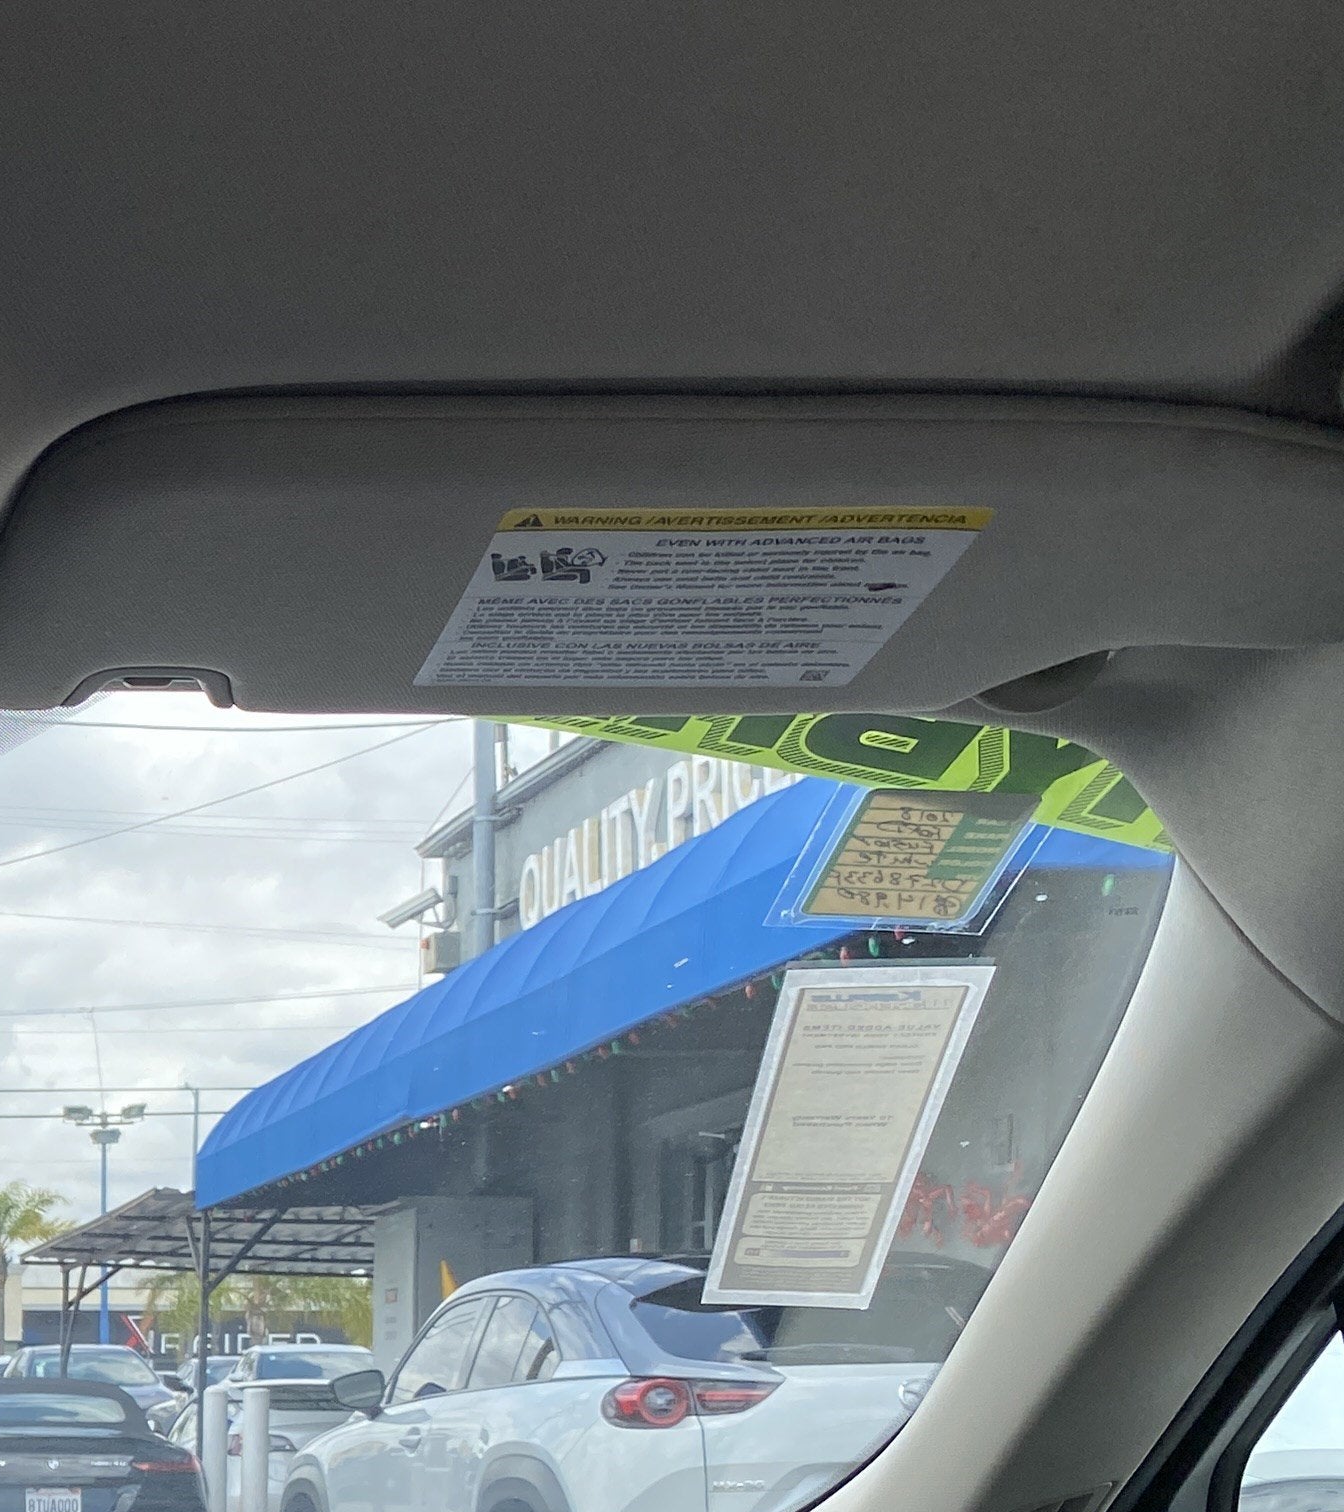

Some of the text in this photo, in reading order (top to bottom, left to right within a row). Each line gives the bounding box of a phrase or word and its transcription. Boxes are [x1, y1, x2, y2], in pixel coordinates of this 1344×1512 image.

[551, 516, 643, 524] WARNING
[656, 538, 701, 546] EVEN
[703, 538, 748, 546] WITH
[749, 537, 842, 545] ADVANCED
[843, 536, 875, 545] AIR
